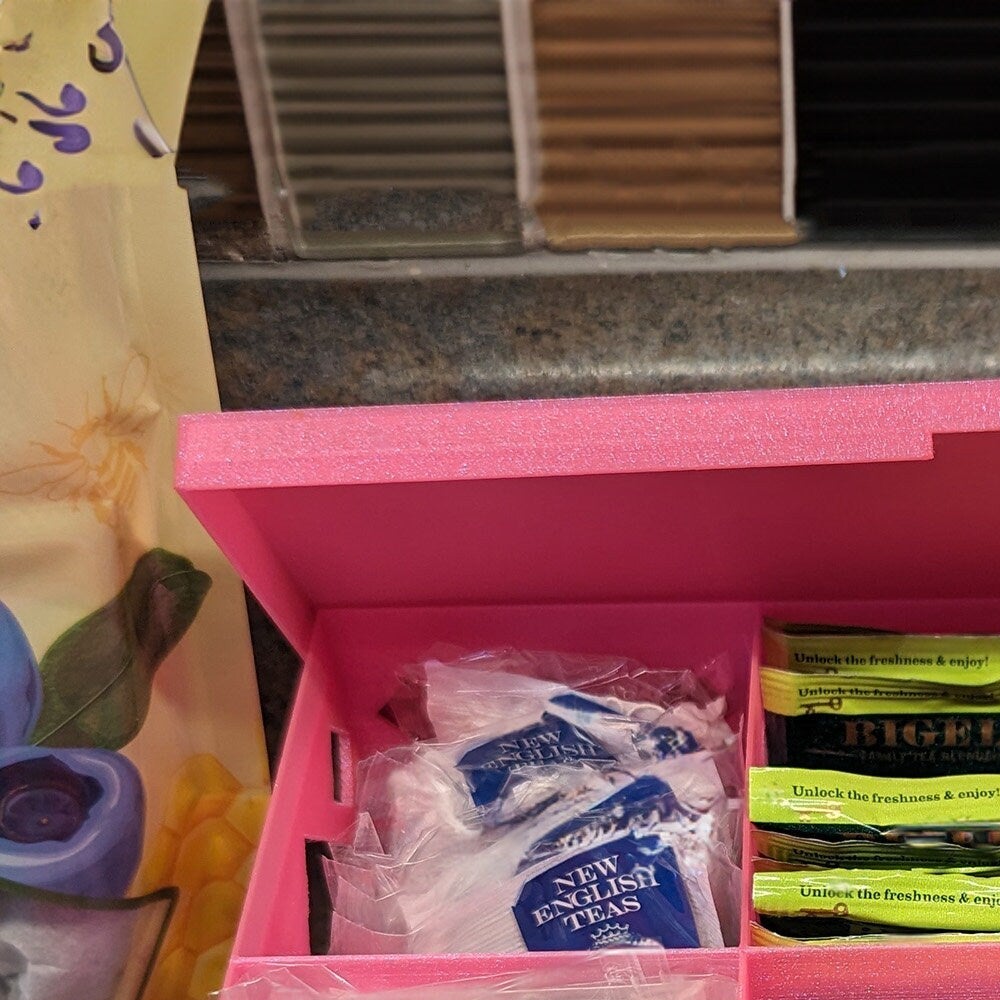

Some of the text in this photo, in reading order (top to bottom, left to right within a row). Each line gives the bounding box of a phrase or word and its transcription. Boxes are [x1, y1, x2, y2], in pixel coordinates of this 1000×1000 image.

[794, 652, 989, 669] Unlock the freshness & enjoy!
[499, 730, 562, 753] NEW
[481, 744, 597, 769] ENGLISH
[792, 785, 1000, 804] Unlock the freshness & enjoy!
[553, 854, 620, 896] NEW
[531, 866, 661, 927] ENGLISH
[800, 885, 854, 899] Unlock
[857, 888, 881, 900] the
[883, 888, 956, 904] freshness
[958, 891, 970, 904] &
[563, 895, 641, 932] TEAS
